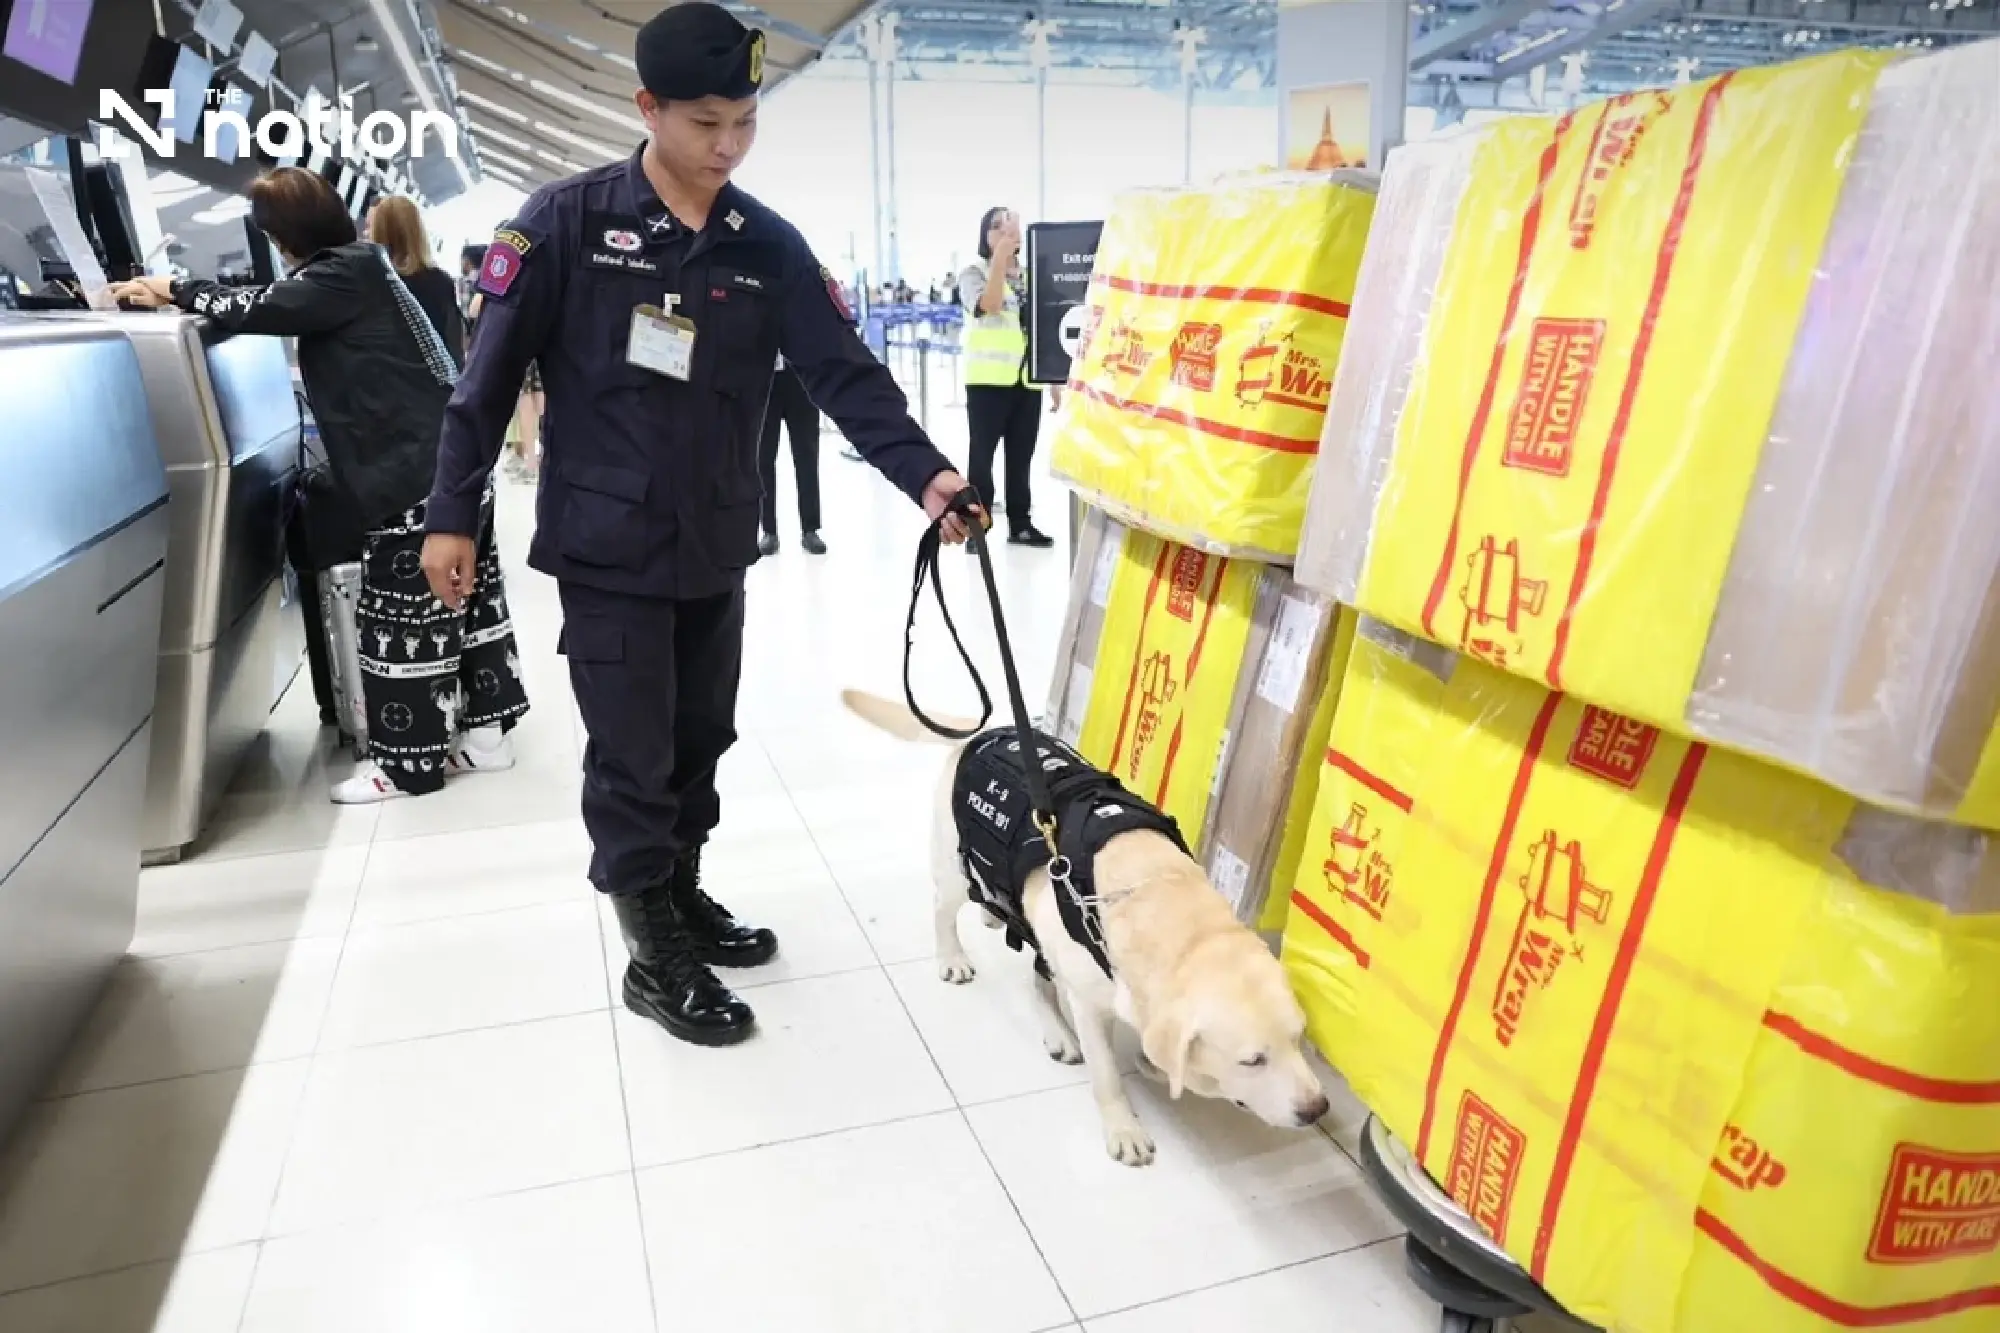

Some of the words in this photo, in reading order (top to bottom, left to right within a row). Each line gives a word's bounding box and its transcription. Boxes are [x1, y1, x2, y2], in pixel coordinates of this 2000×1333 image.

[1062, 253, 1081, 264] Exit
[1284, 350, 1321, 369] Mrs.
[1524, 334, 1560, 393] WITH
[1536, 334, 1595, 458] HANDLE
[1493, 930, 1553, 1049] Wrap
[1893, 1220, 1956, 1249] WITH
